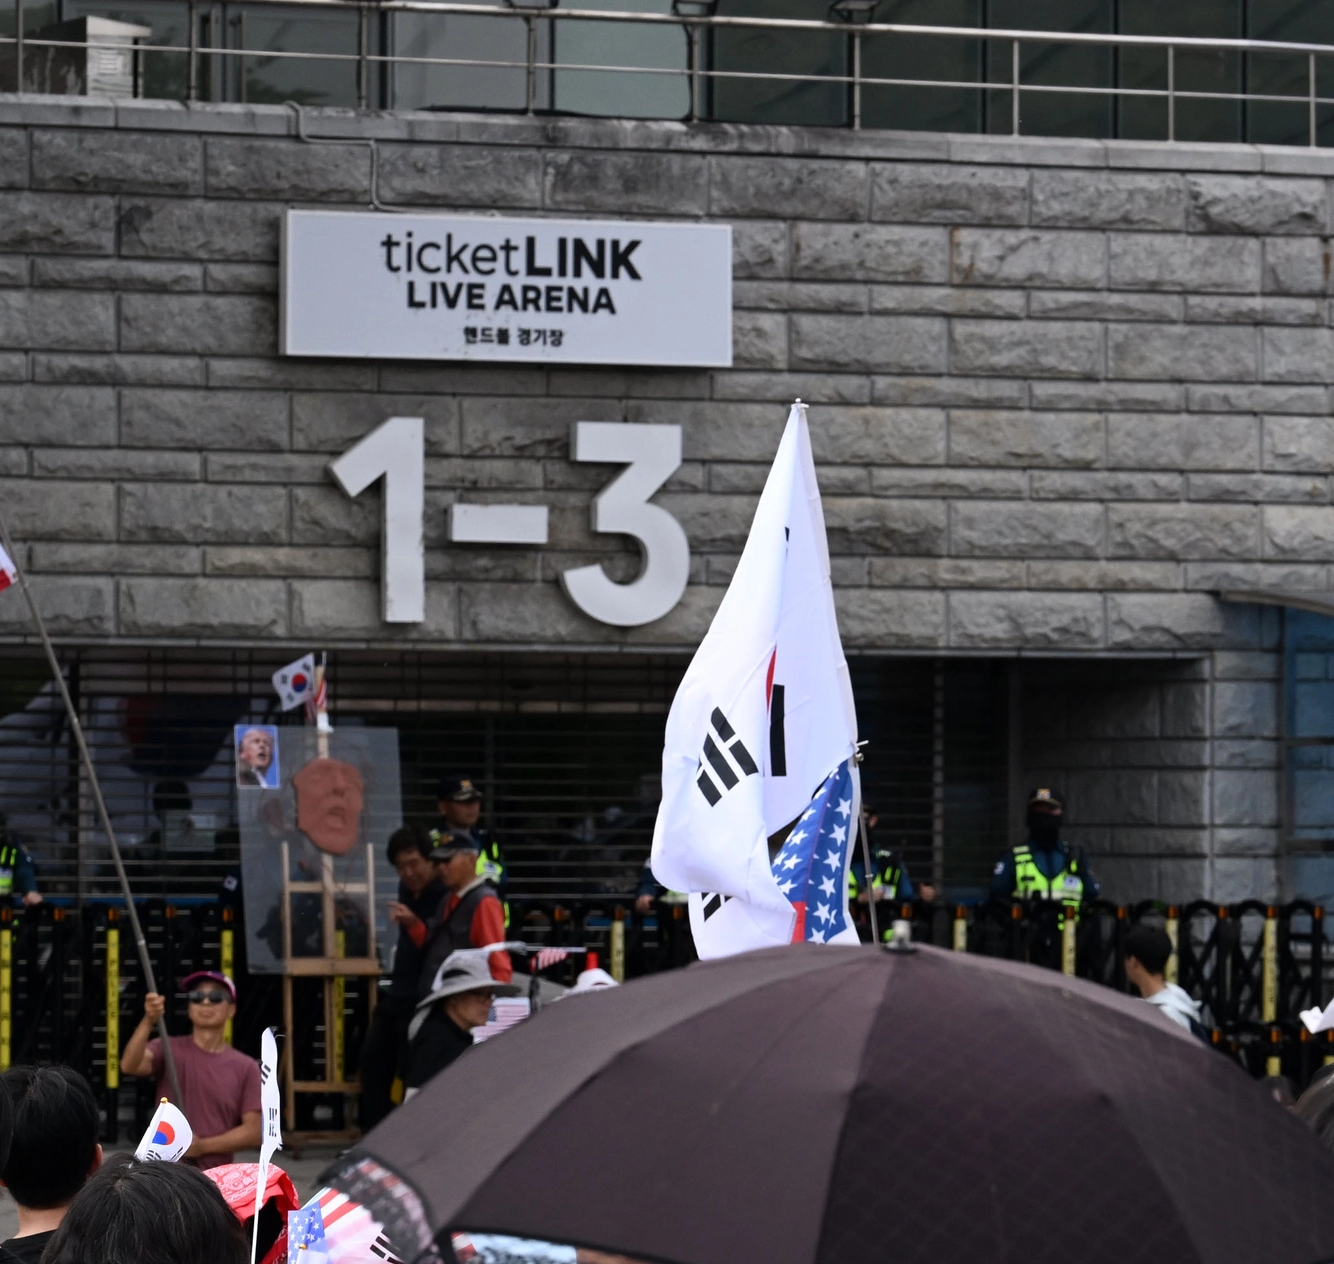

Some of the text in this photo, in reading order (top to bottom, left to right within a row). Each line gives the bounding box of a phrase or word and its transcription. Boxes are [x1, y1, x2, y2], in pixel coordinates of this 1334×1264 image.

[380, 231, 642, 281] ticketLINK
[407, 281, 617, 315] LIVE ARENA
[463, 326, 564, 348] 핸드볼 경기장
[327, 416, 691, 627] 1-3
